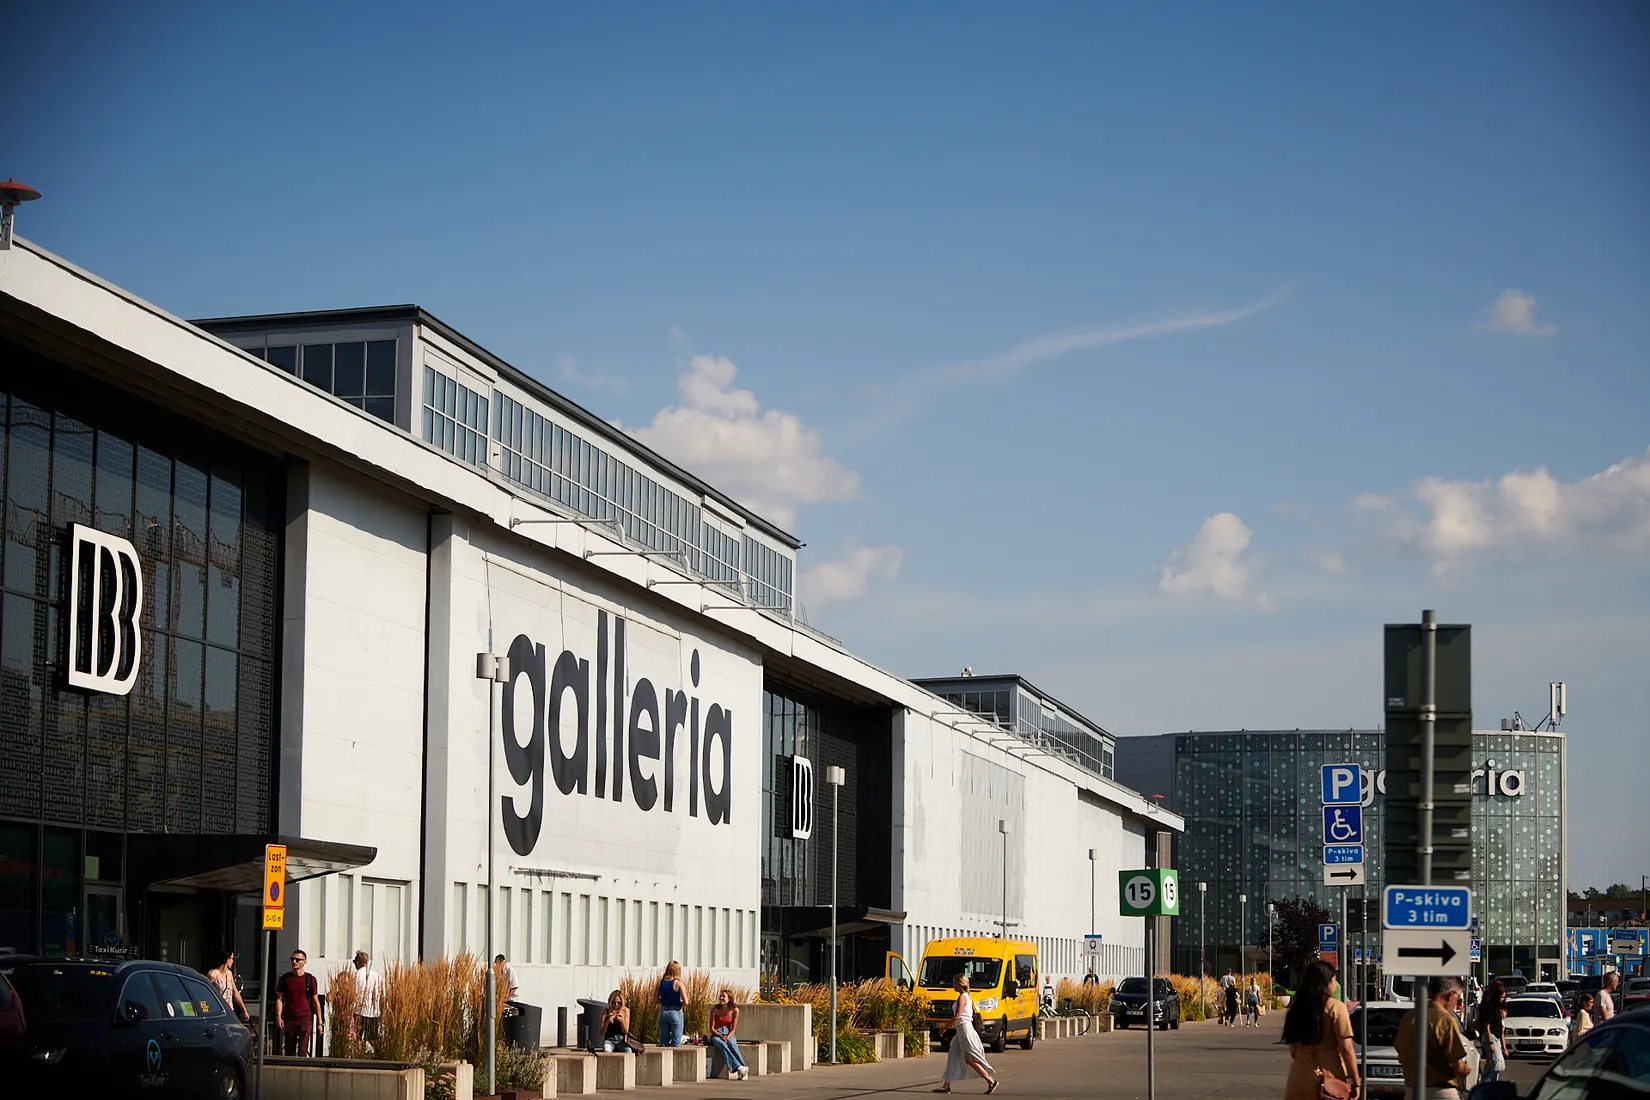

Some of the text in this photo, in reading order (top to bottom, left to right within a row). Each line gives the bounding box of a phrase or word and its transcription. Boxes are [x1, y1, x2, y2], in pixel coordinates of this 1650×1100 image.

[501, 608, 732, 857] galleria
[1332, 768, 1354, 800] P
[268, 850, 285, 862] Last-
[1328, 847, 1359, 855] P-skiva
[270, 865, 282, 873] zon
[1128, 882, 1151, 901] 15
[1164, 882, 1175, 900] 15
[1395, 892, 1461, 906] P-skiva
[265, 914, 277, 922] 0-10
[1408, 909, 1449, 922] 3 tim
[1323, 926, 1334, 941] P
